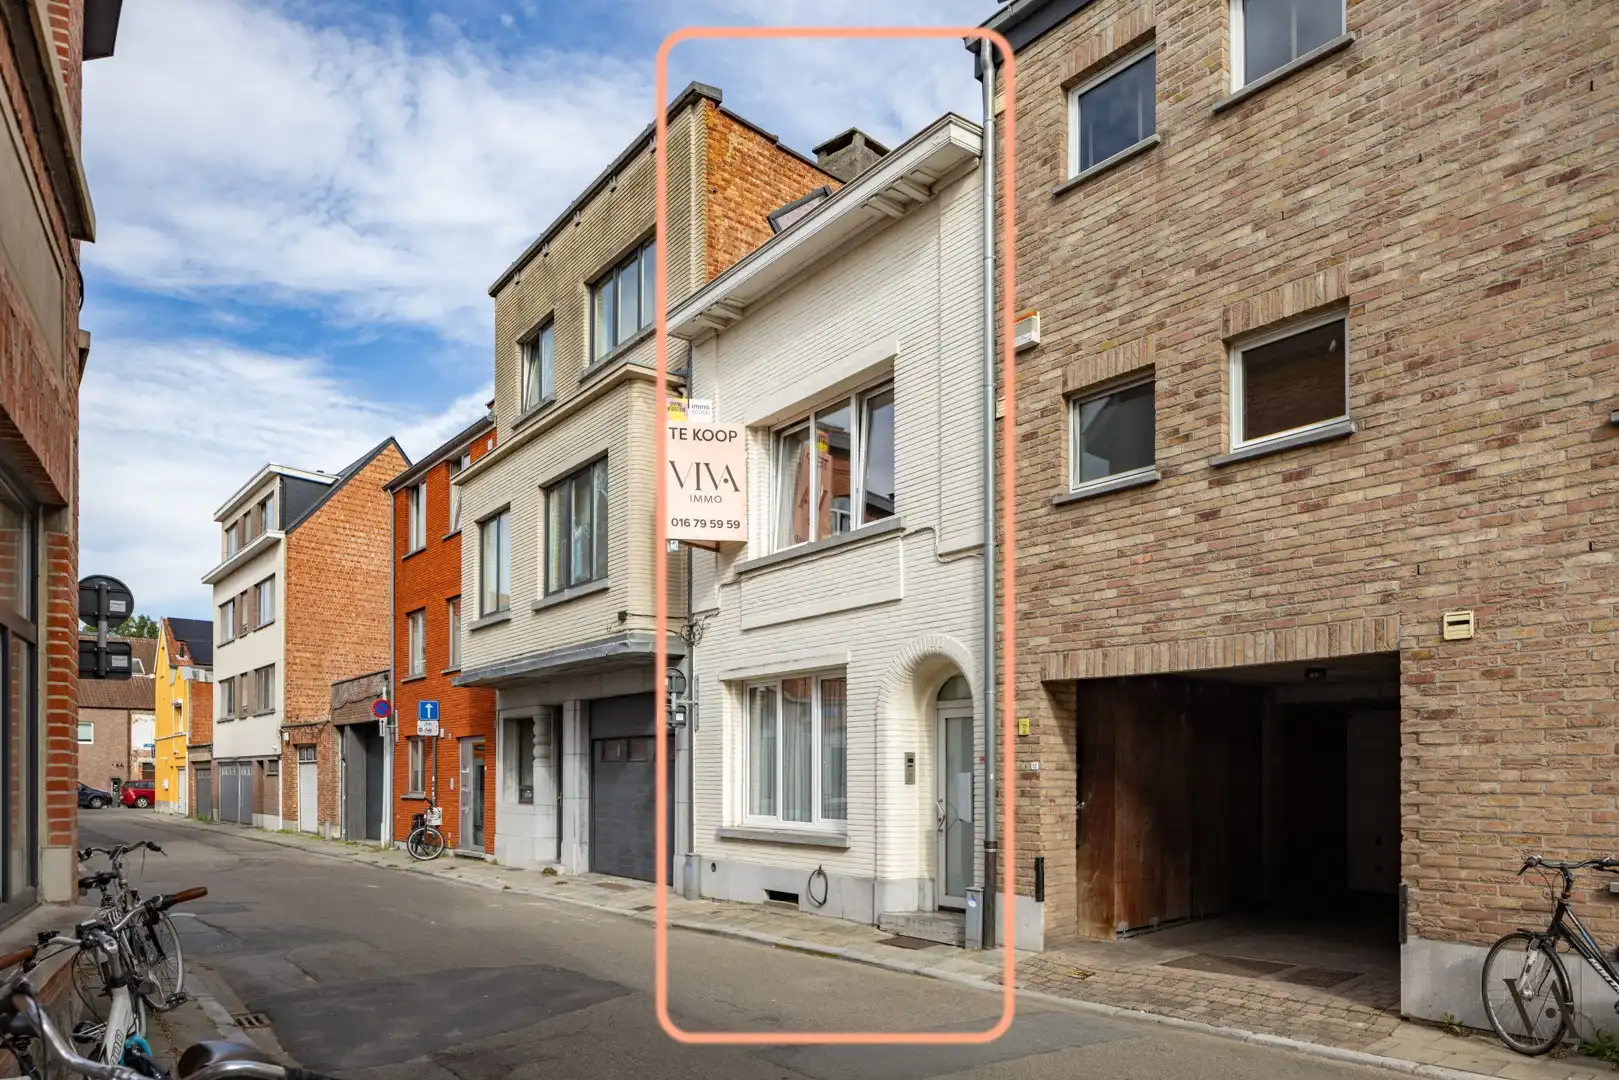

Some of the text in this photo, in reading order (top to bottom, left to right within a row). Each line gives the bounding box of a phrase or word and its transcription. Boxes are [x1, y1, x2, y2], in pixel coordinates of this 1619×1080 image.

[668, 427, 738, 442] TE KOOP
[669, 460, 740, 492] VIVA
[690, 494, 723, 503] IMMO
[671, 518, 741, 529] 016 79 59 59
